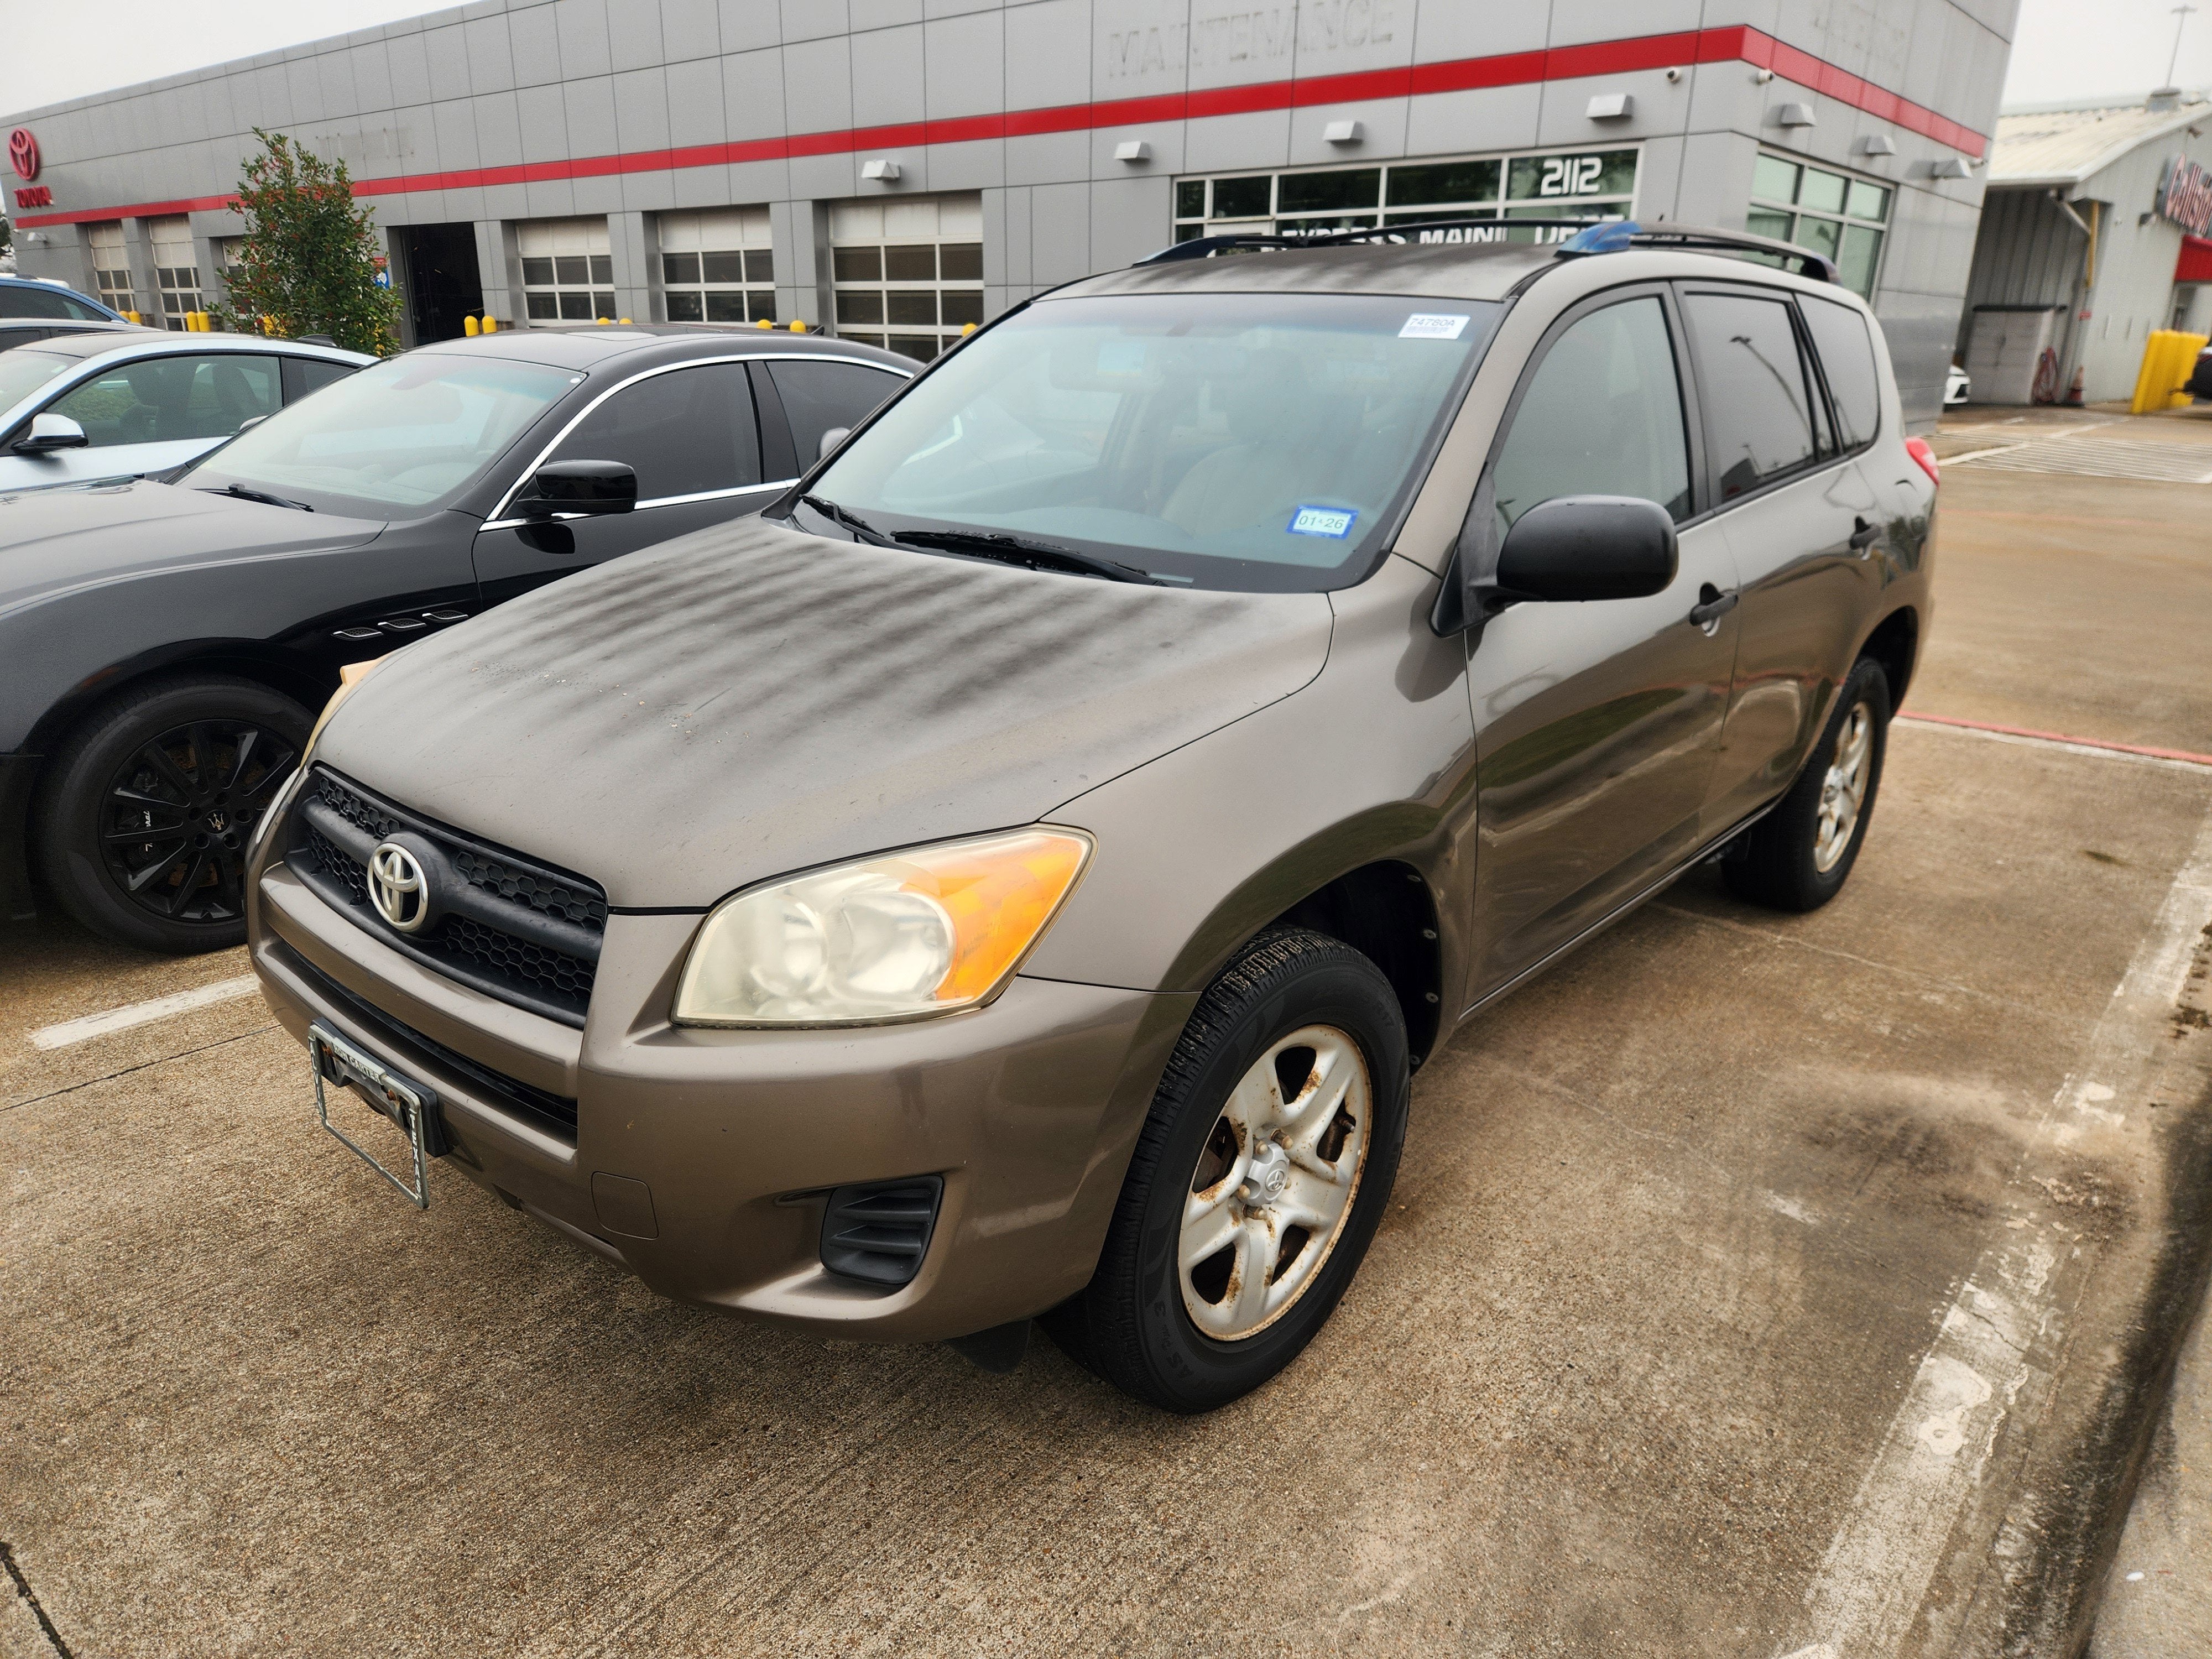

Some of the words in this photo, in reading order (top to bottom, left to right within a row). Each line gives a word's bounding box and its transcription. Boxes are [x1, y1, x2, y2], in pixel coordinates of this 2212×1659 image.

[1108, 0, 1394, 77] MAINTENANCE
[1541, 156, 1603, 196] 2112
[1410, 318, 1455, 327] 74780A
[1299, 515, 1344, 529] 01-26
[410, 1113, 422, 1194] TEXAS
